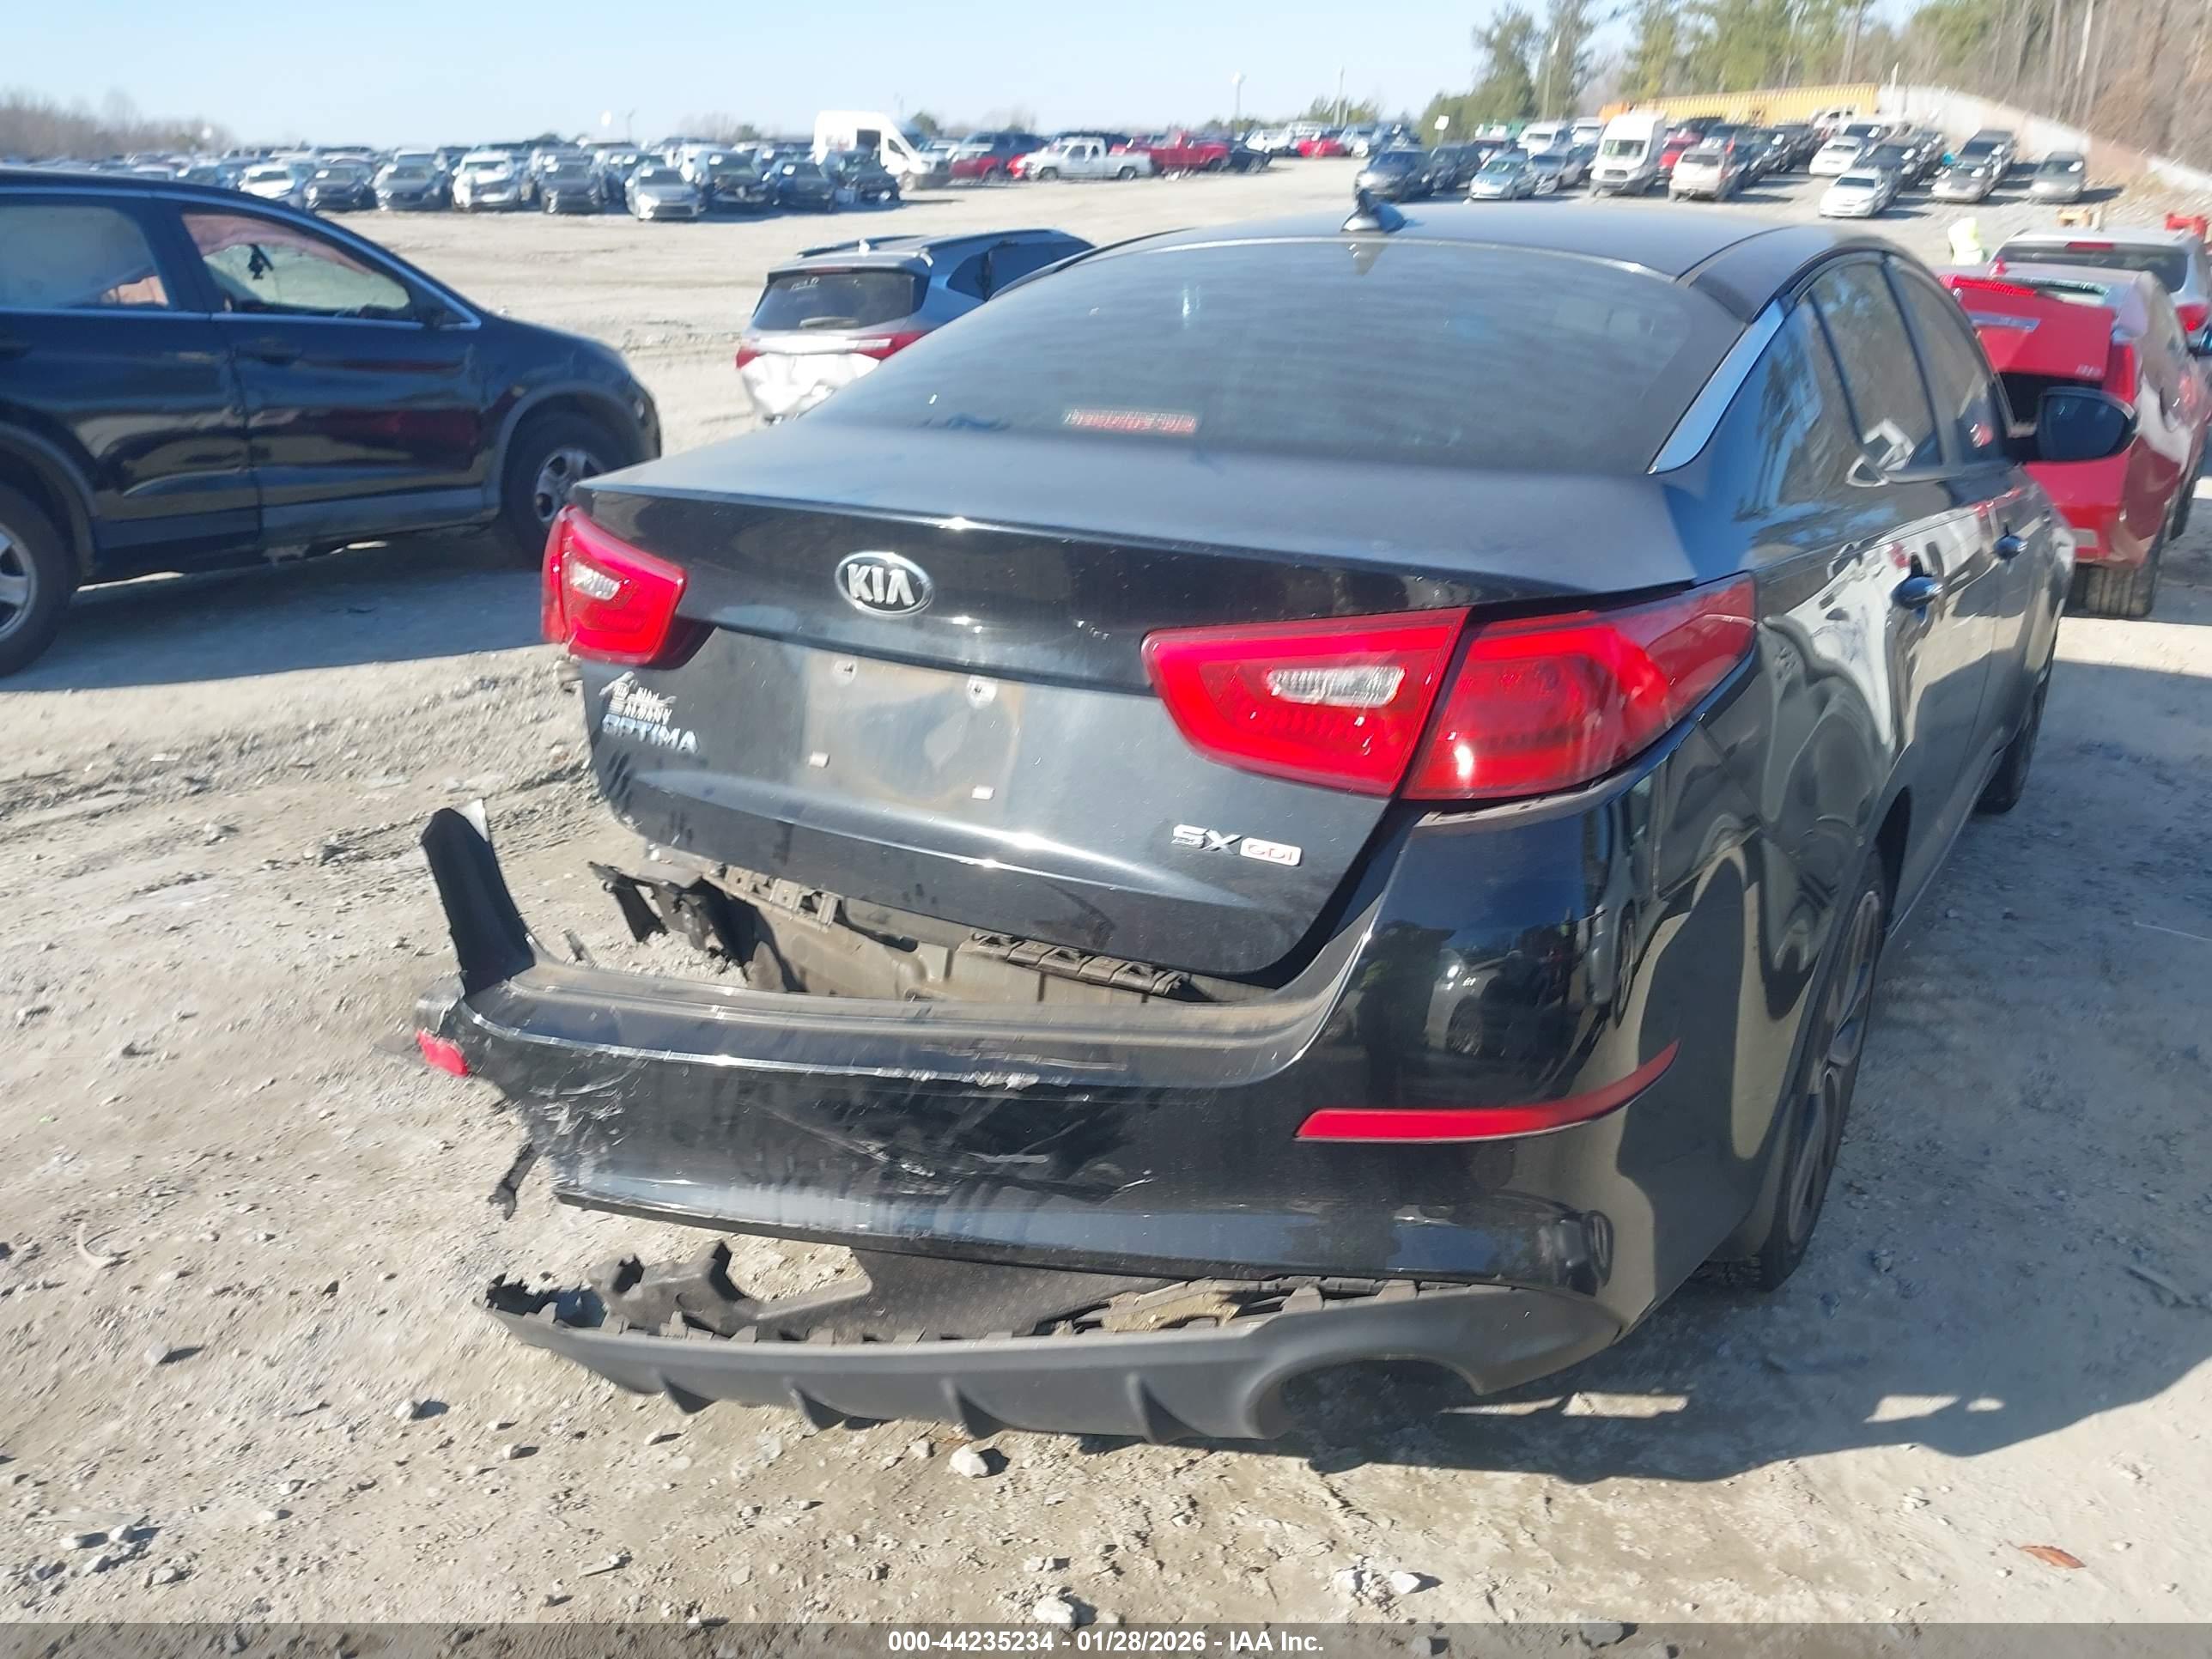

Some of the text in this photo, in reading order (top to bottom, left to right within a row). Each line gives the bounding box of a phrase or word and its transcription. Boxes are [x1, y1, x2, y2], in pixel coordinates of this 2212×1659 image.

[848, 563, 915, 606] KIA
[603, 714, 698, 754] OPTIMA
[1170, 823, 1243, 855] SX
